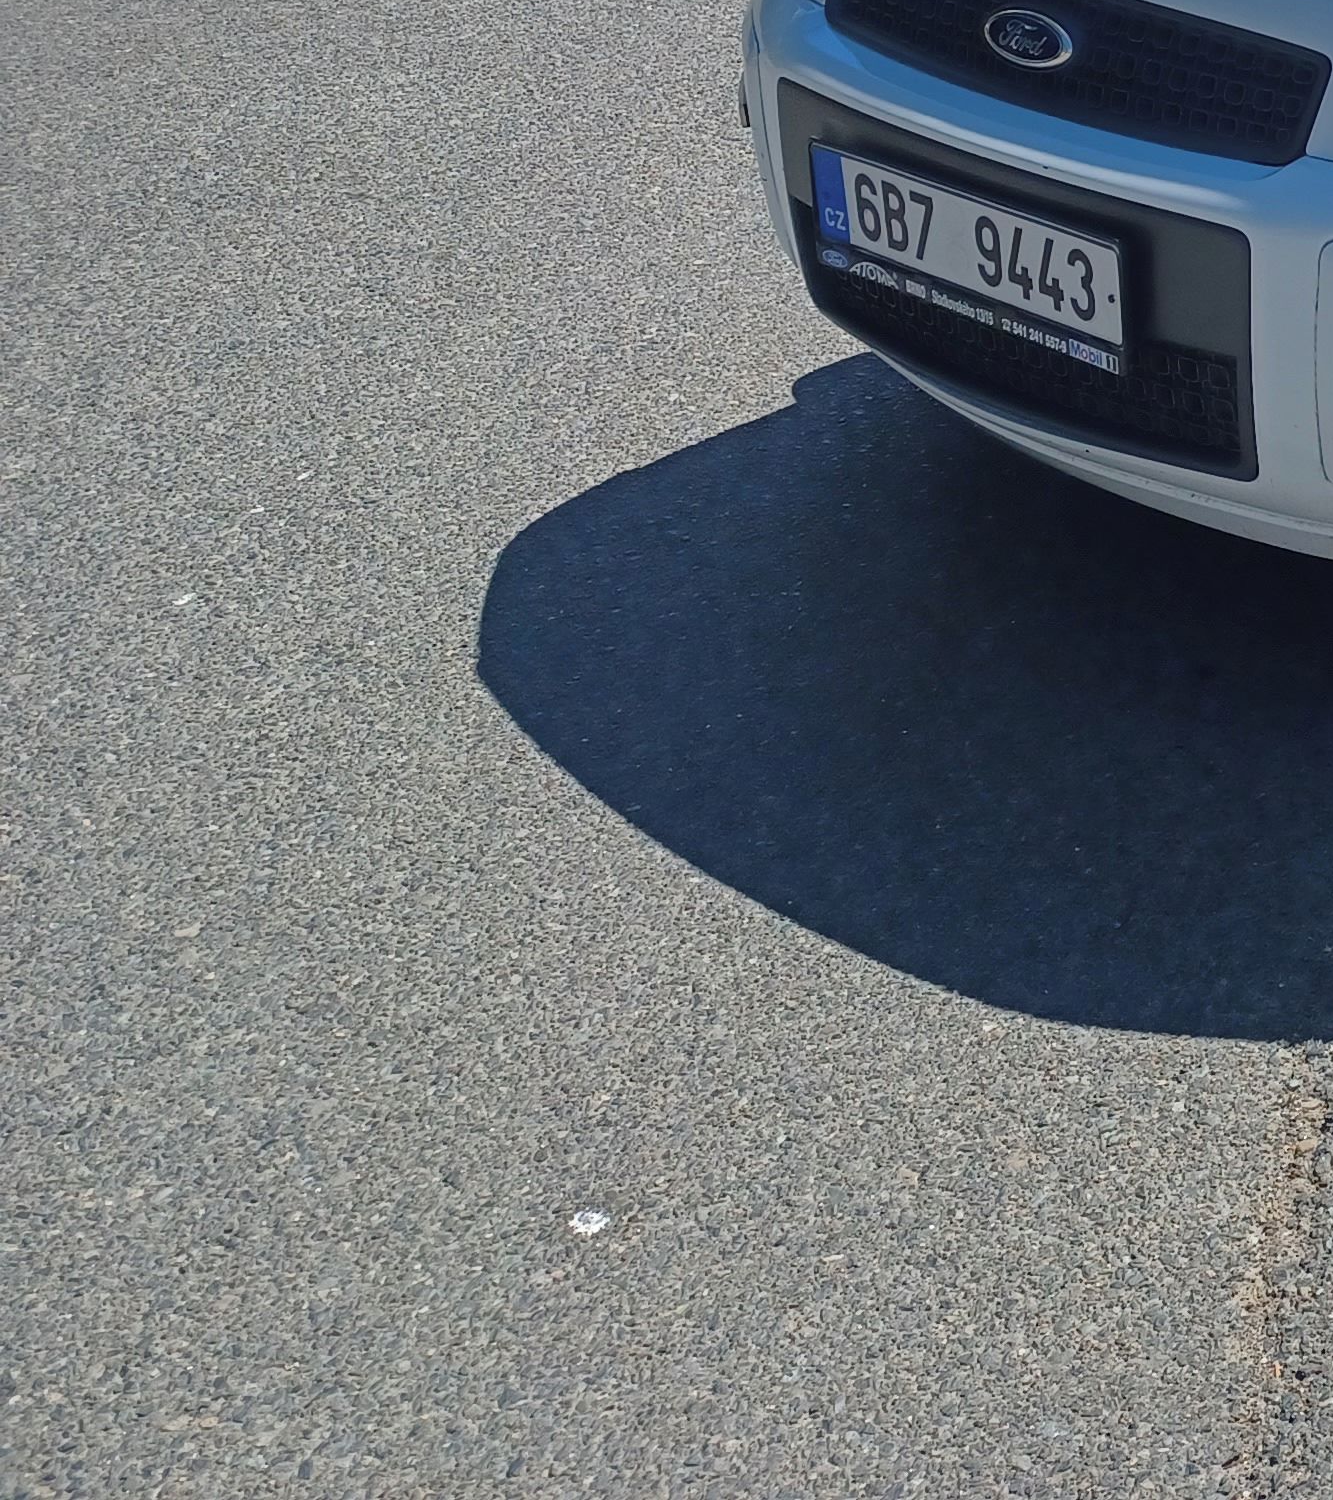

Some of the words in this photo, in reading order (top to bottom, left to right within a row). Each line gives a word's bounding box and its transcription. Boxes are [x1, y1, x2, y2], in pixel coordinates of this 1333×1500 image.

[998, 19, 1048, 56] Ford
[824, 207, 847, 231] CZ
[854, 173, 934, 261] 6B7
[974, 216, 1096, 321] 9443
[1012, 321, 1027, 338] 541
[1028, 328, 1043, 345] 241
[1070, 340, 1103, 367] Mobil
